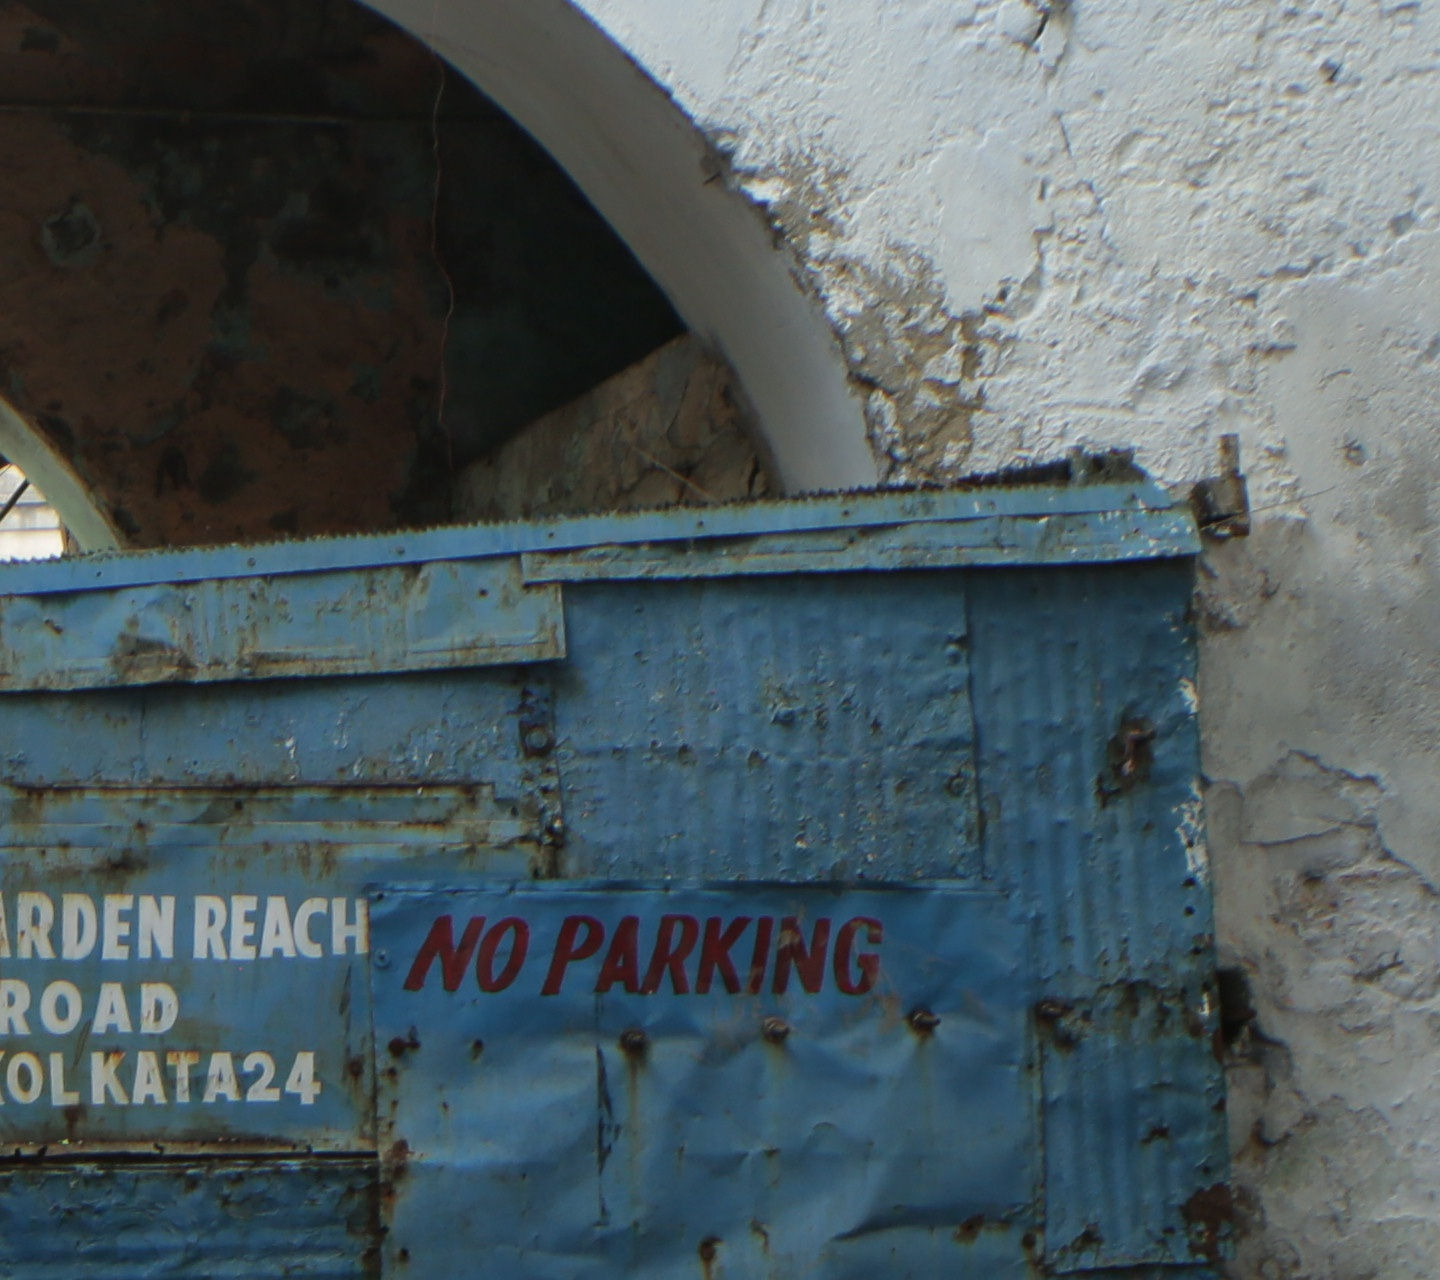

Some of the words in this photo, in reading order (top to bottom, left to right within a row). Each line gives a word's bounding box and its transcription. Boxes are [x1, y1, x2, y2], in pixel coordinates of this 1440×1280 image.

[193, 894, 369, 960] REACH
[402, 915, 530, 992] NO
[540, 914, 883, 996] PARKING
